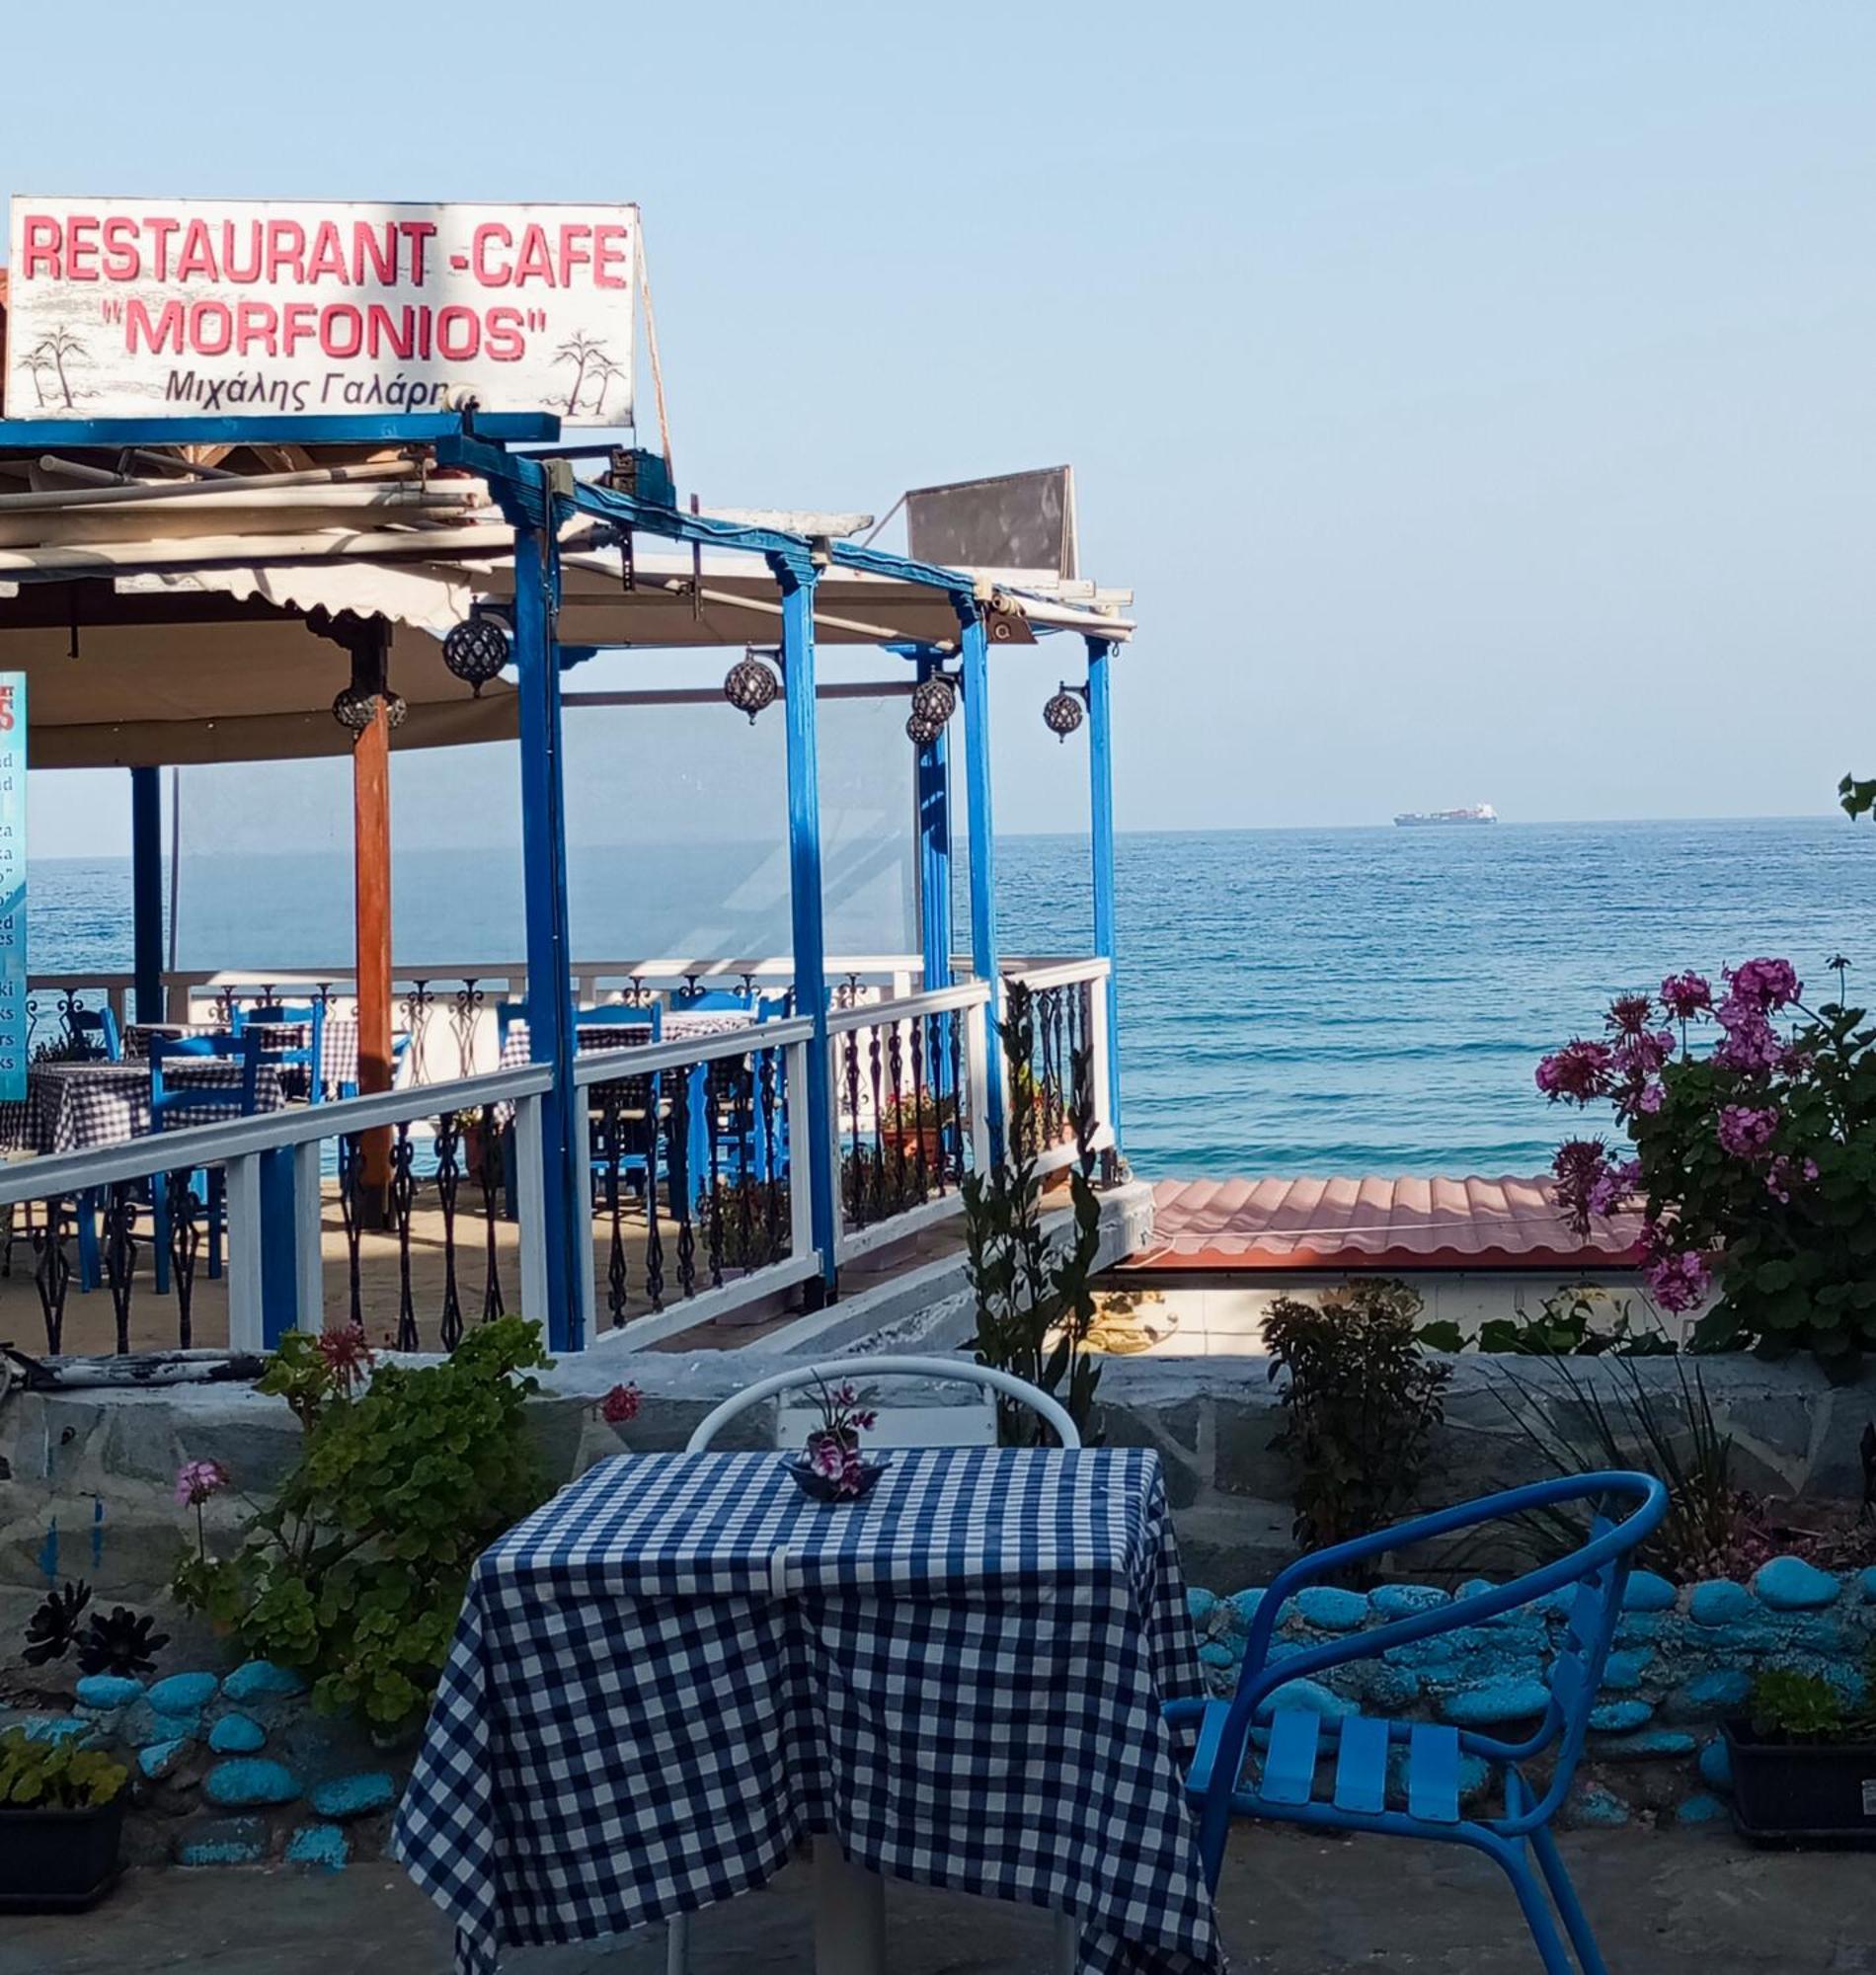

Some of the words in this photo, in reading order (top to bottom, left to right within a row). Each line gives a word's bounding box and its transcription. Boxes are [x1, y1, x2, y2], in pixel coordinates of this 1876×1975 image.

[23, 214, 437, 287] RESTAURANT
[449, 222, 628, 288] -CAFE
[102, 299, 547, 361] "MORFONIOS"
[165, 369, 311, 412] Μιχάλης
[321, 373, 451, 413] Γαλάρη
